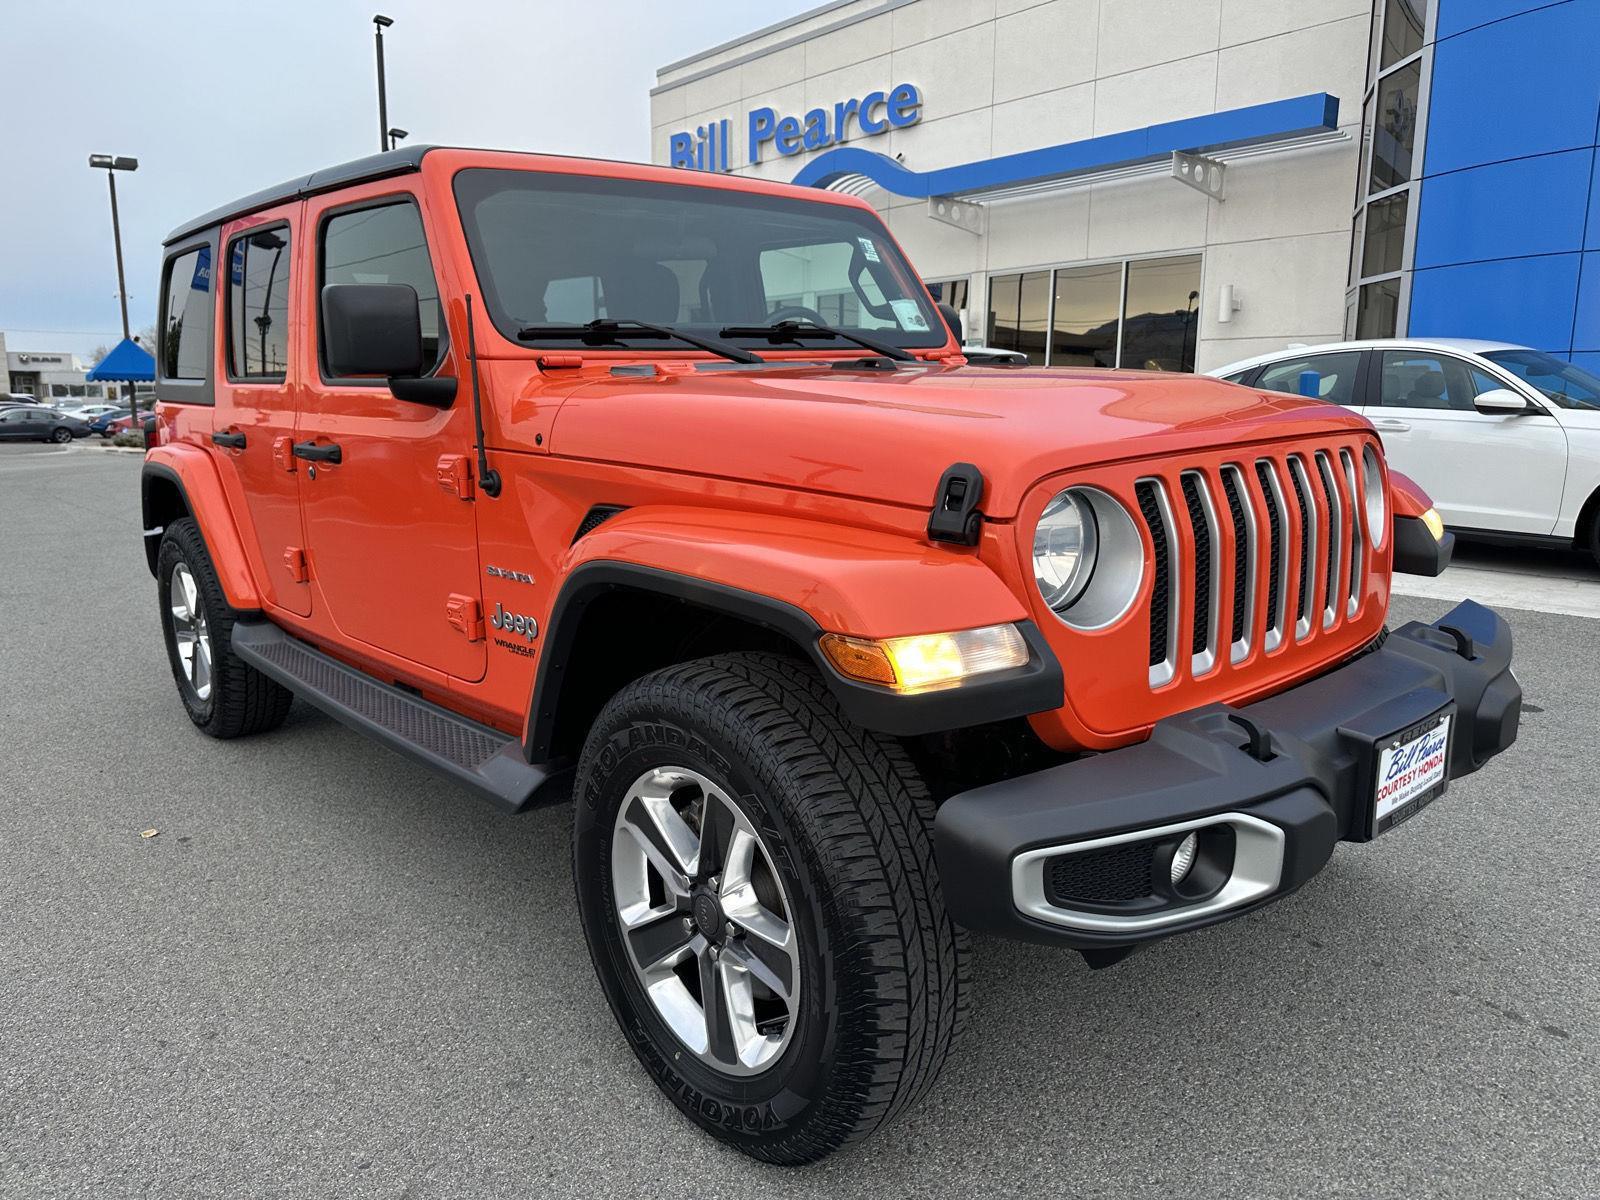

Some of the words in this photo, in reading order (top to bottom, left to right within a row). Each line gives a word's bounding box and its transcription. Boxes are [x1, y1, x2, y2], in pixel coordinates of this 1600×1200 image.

[670, 118, 732, 172] Bill
[749, 83, 922, 165] Pearce
[490, 602, 539, 643] Jeep
[1376, 768, 1416, 802] COURTESY
[1418, 752, 1443, 778] HONDA
[1385, 743, 1418, 781] Bill
[1415, 733, 1446, 764] Pearce
